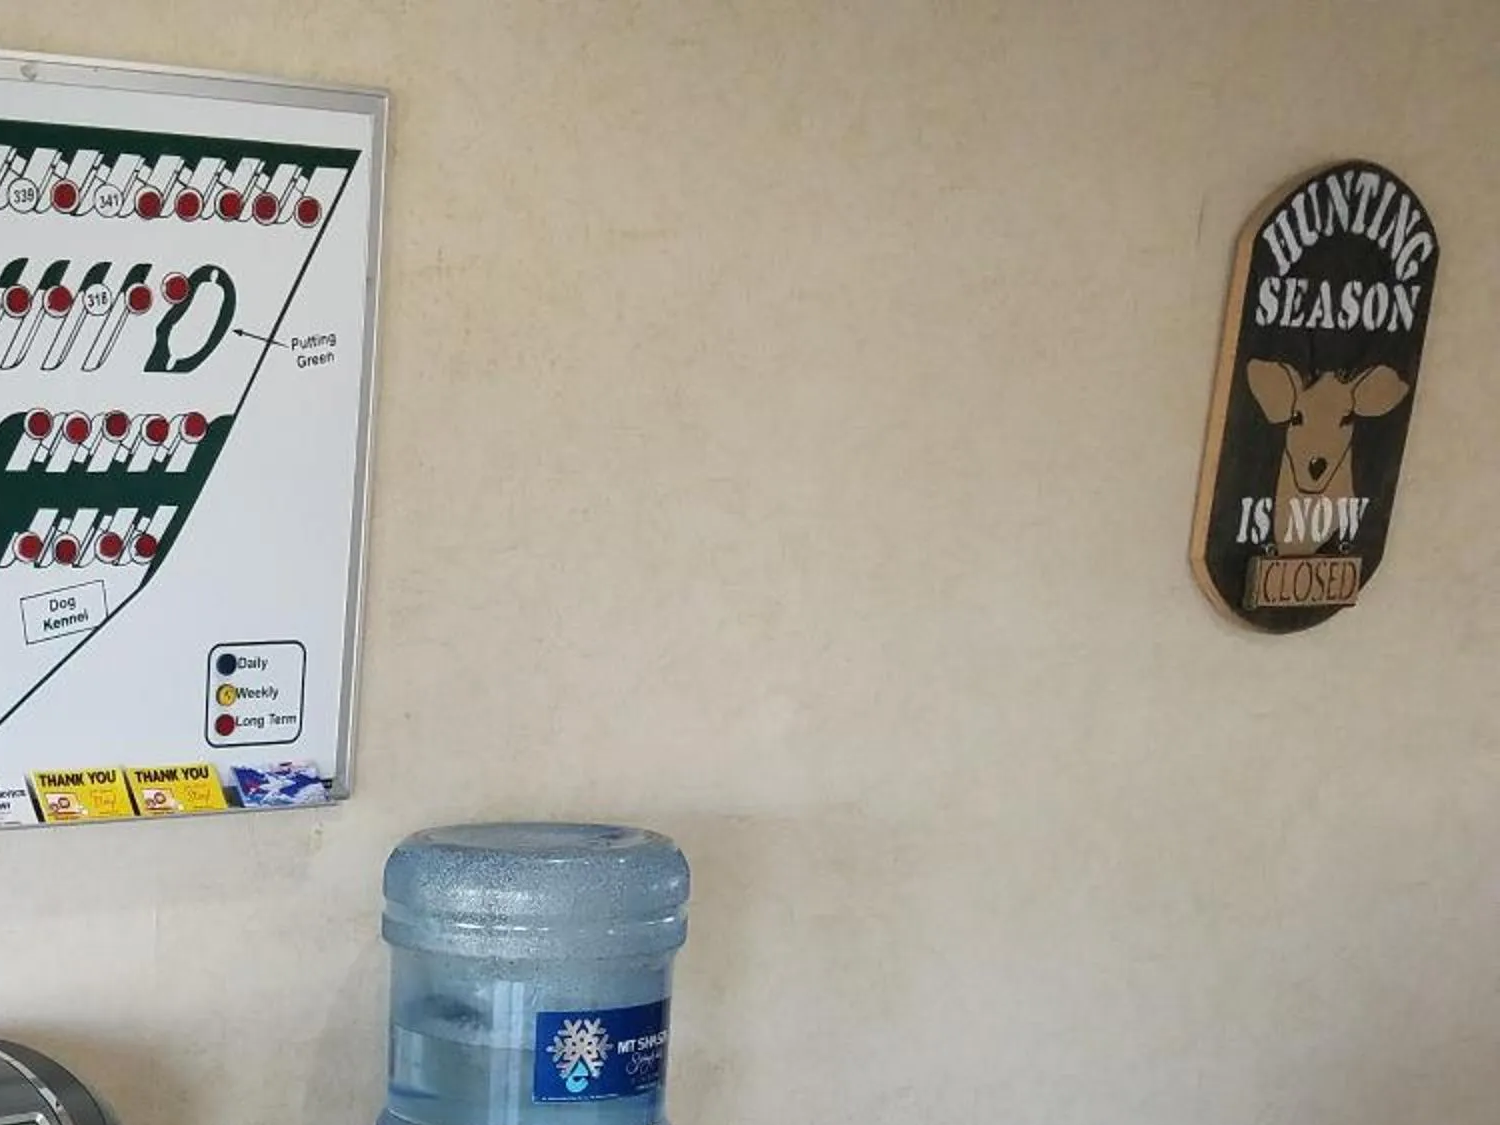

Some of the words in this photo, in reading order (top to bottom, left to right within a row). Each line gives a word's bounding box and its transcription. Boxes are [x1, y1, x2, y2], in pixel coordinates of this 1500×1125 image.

[1262, 171, 1434, 282] HUNTING
[1255, 277, 1421, 332] SEASON
[291, 333, 337, 351] Putting
[296, 352, 335, 369] Green
[1236, 496, 1273, 545] IS
[1283, 496, 1370, 544] NOW
[1263, 560, 1358, 603] CLOSED
[49, 597, 77, 613] Dog
[43, 610, 89, 632] Kennel
[237, 656, 269, 671] Daily
[236, 685, 279, 701] Weekly
[235, 715, 265, 729] Long
[268, 713, 297, 725] Term
[38, 772, 85, 787] THANK
[87, 769, 117, 785] YOU
[134, 768, 179, 783] THANK
[180, 765, 209, 781] YOU
